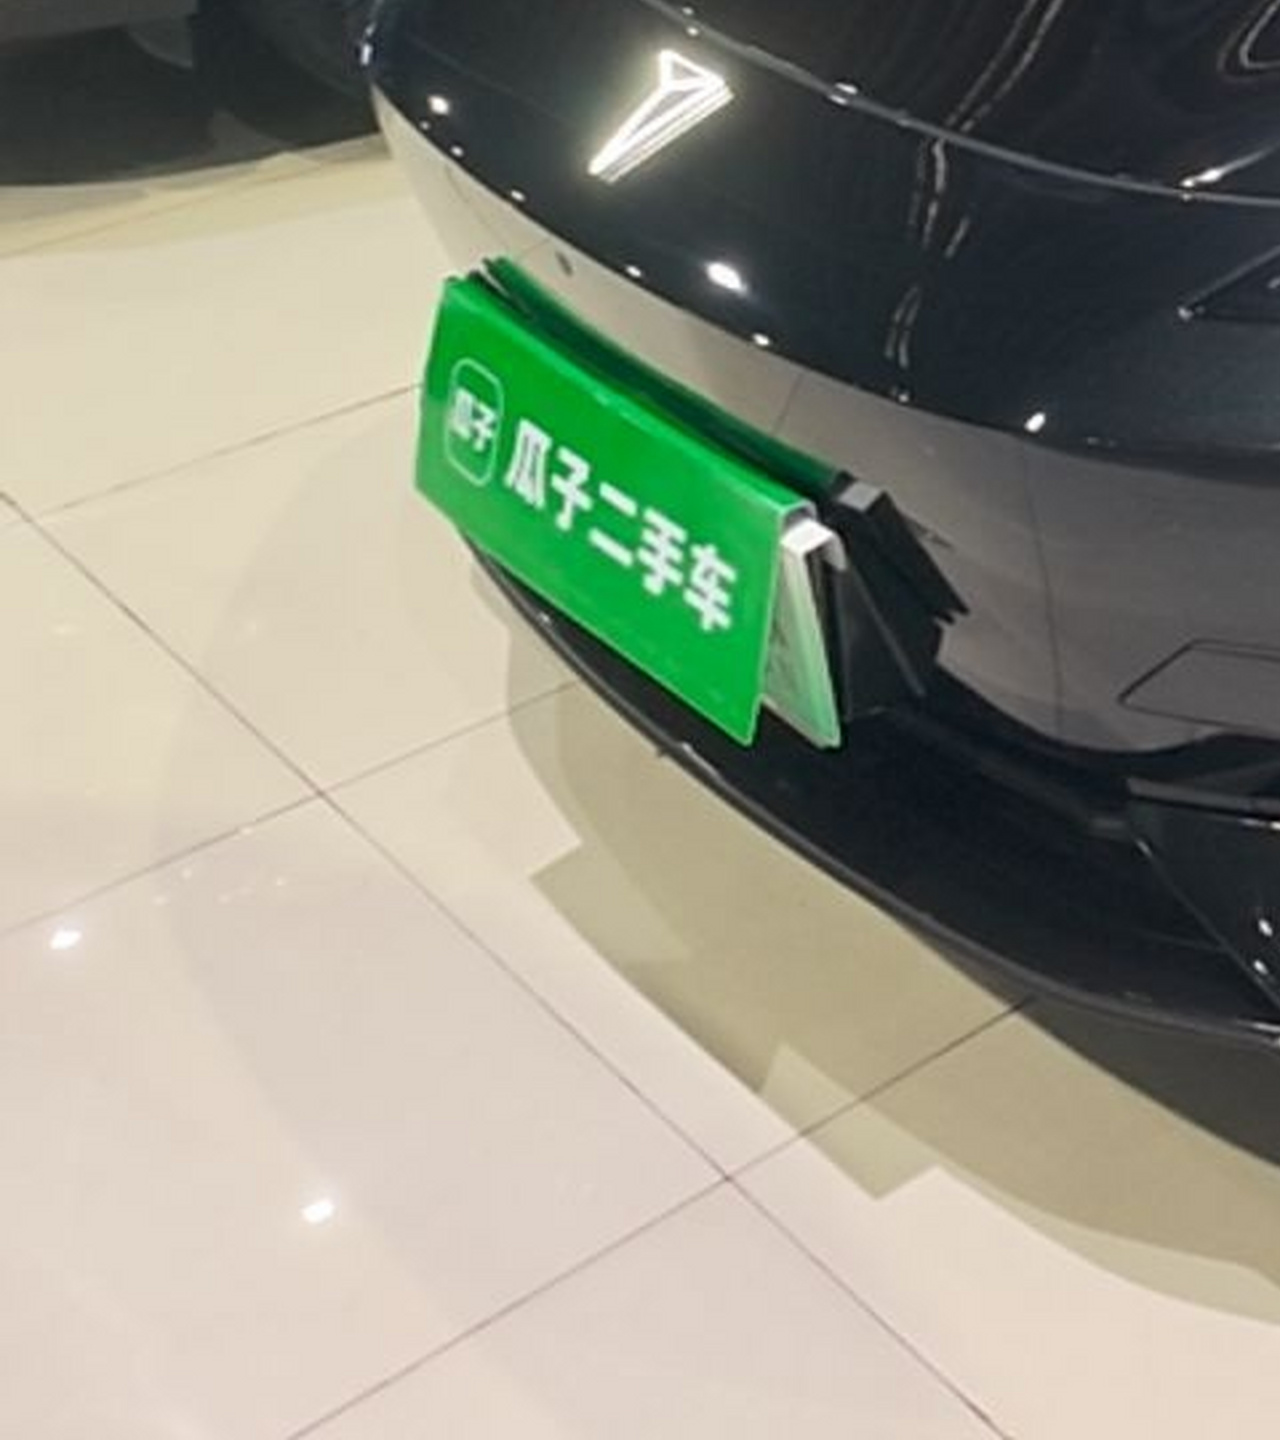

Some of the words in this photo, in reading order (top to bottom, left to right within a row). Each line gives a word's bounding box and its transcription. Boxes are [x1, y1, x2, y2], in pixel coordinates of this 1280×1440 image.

[503, 418, 738, 633] 瓜子二手车
